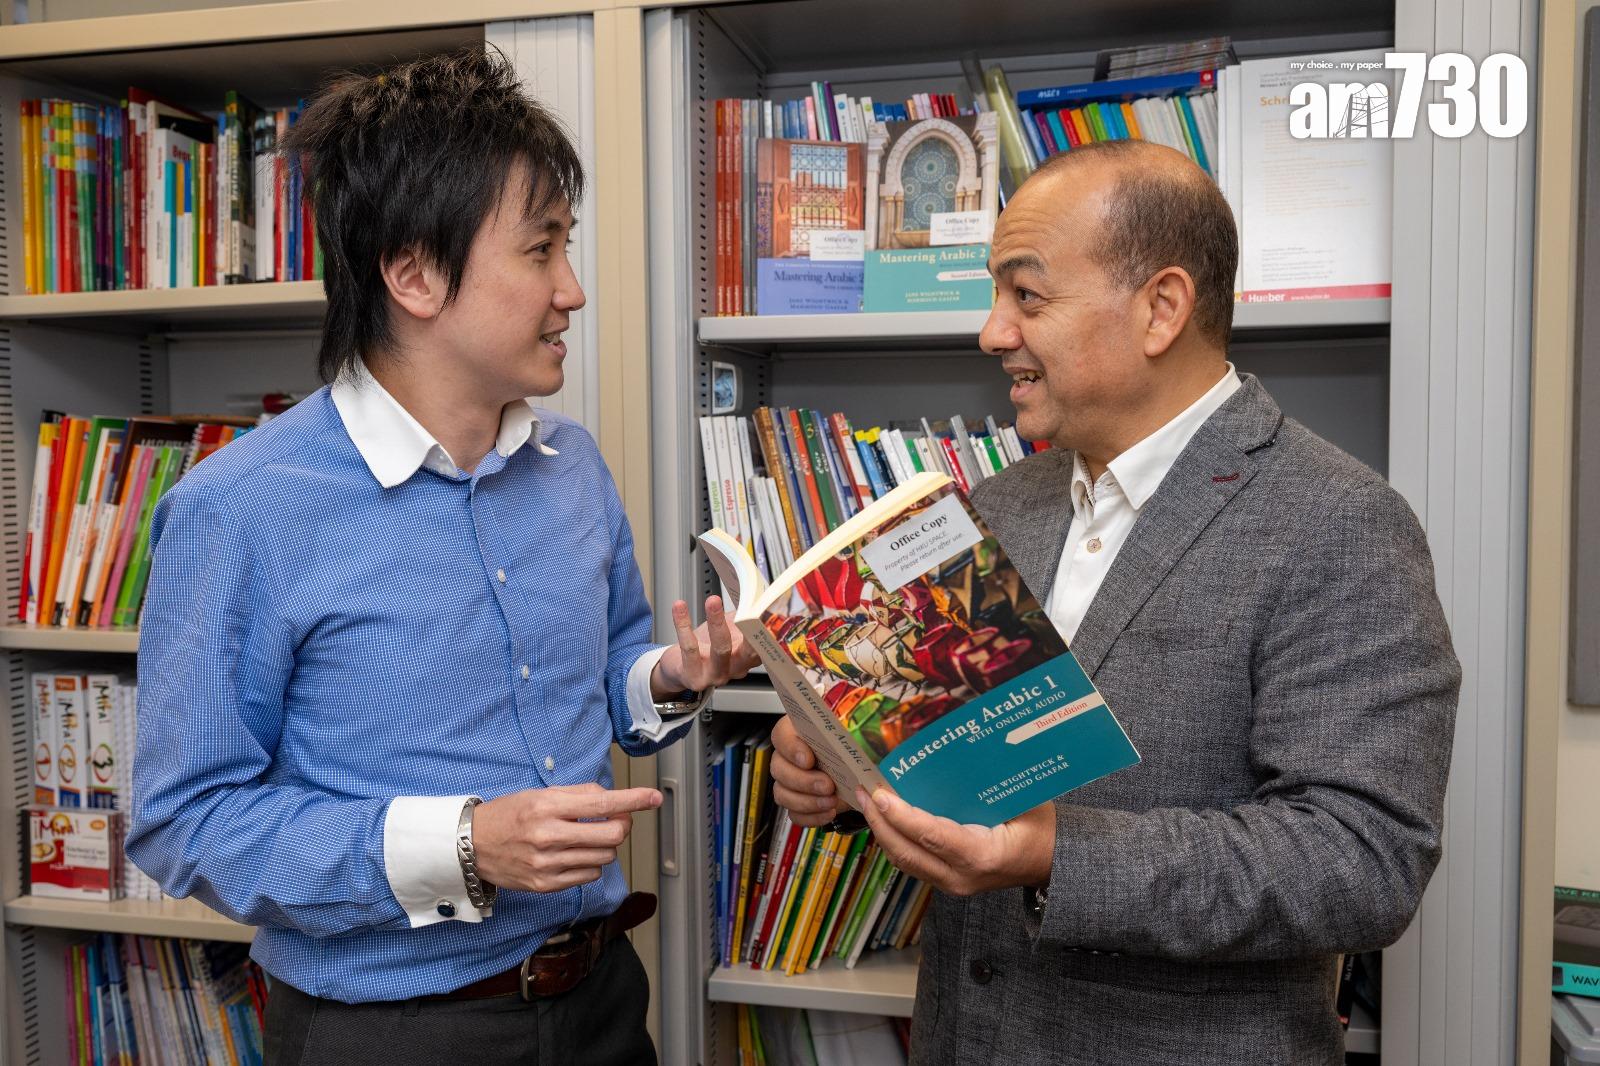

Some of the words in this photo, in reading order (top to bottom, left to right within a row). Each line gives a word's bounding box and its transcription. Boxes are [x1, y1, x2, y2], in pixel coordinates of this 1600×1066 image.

[880, 253, 936, 264] Mastering
[939, 249, 976, 261] Arabic
[980, 248, 986, 258] 2
[774, 270, 823, 284] Mastering
[824, 271, 856, 283] Arabic
[1248, 293, 1285, 303] Hueber
[711, 480, 721, 513] Espresso
[724, 479, 734, 511] Espresso
[890, 530, 920, 552] Office
[921, 513, 948, 534] Copy
[885, 552, 909, 571] Property
[909, 548, 917, 557] of
[929, 531, 946, 545] SPACE
[900, 557, 919, 572] Please
[919, 547, 937, 560] return
[937, 538, 952, 551] after
[793, 679, 836, 732] Mastering
[835, 732, 865, 764] Arabic
[889, 718, 981, 781] Mastering
[981, 685, 1042, 723] Arabic
[1044, 675, 1058, 690] 1
[966, 726, 994, 744] WITH
[996, 708, 1033, 730] ONLINE
[1035, 690, 1066, 711] AUDIO
[1034, 715, 1057, 730] Third
[1057, 701, 1088, 719] Edition
[92, 757, 113, 769] 3
[977, 785, 1000, 801] JANE
[1000, 758, 1055, 788] WIGHTWICK
[985, 778, 1034, 806] MAHMOUD
[1035, 762, 1070, 781] GAAFAR
